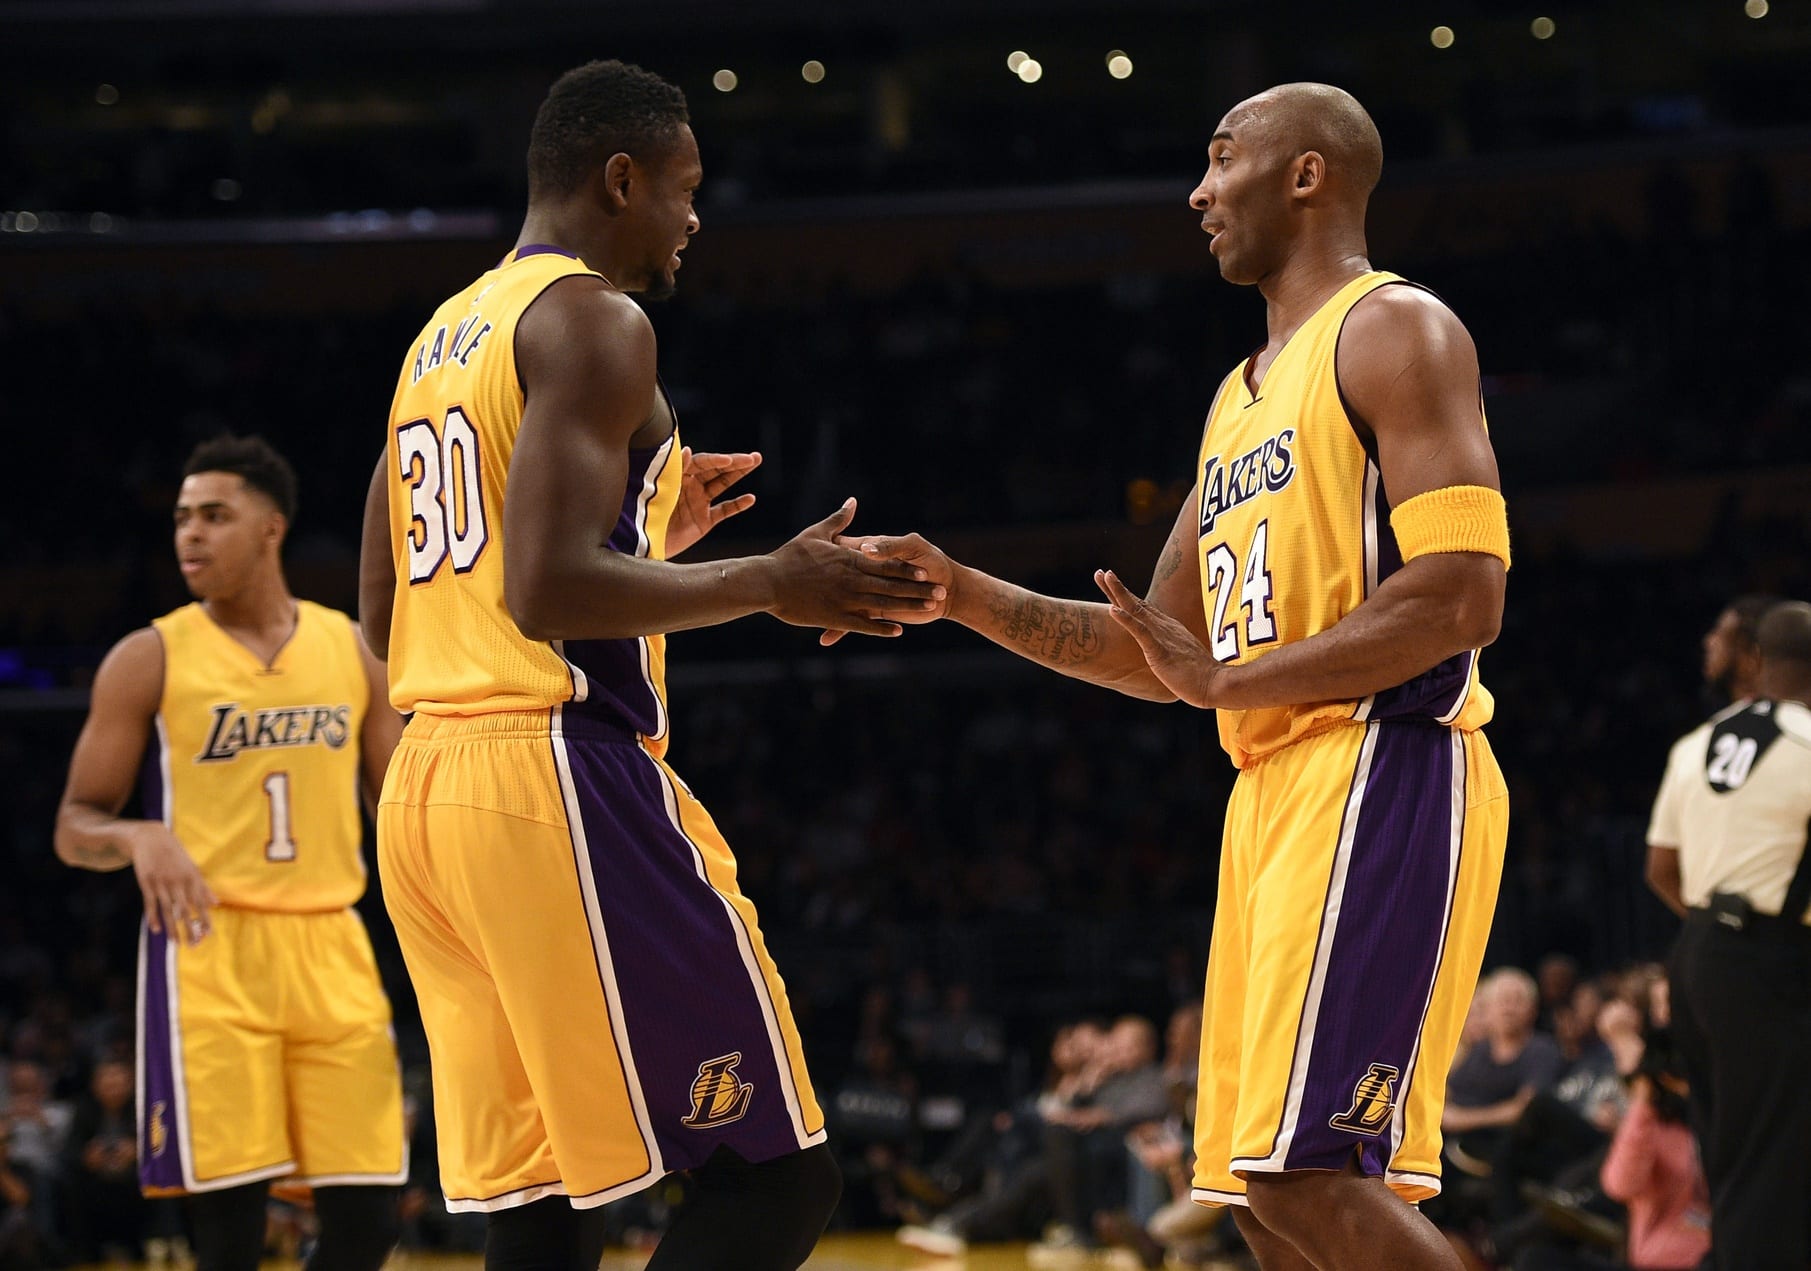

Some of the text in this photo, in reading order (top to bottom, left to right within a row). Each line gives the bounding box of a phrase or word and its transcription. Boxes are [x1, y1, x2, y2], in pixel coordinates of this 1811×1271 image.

[396, 404, 489, 587] 30
[1198, 428, 1297, 541] LAKERS
[1205, 517, 1278, 664] 24
[194, 702, 351, 764] LAKERS
[1707, 733, 1758, 789] 20
[263, 770, 297, 863] 1
